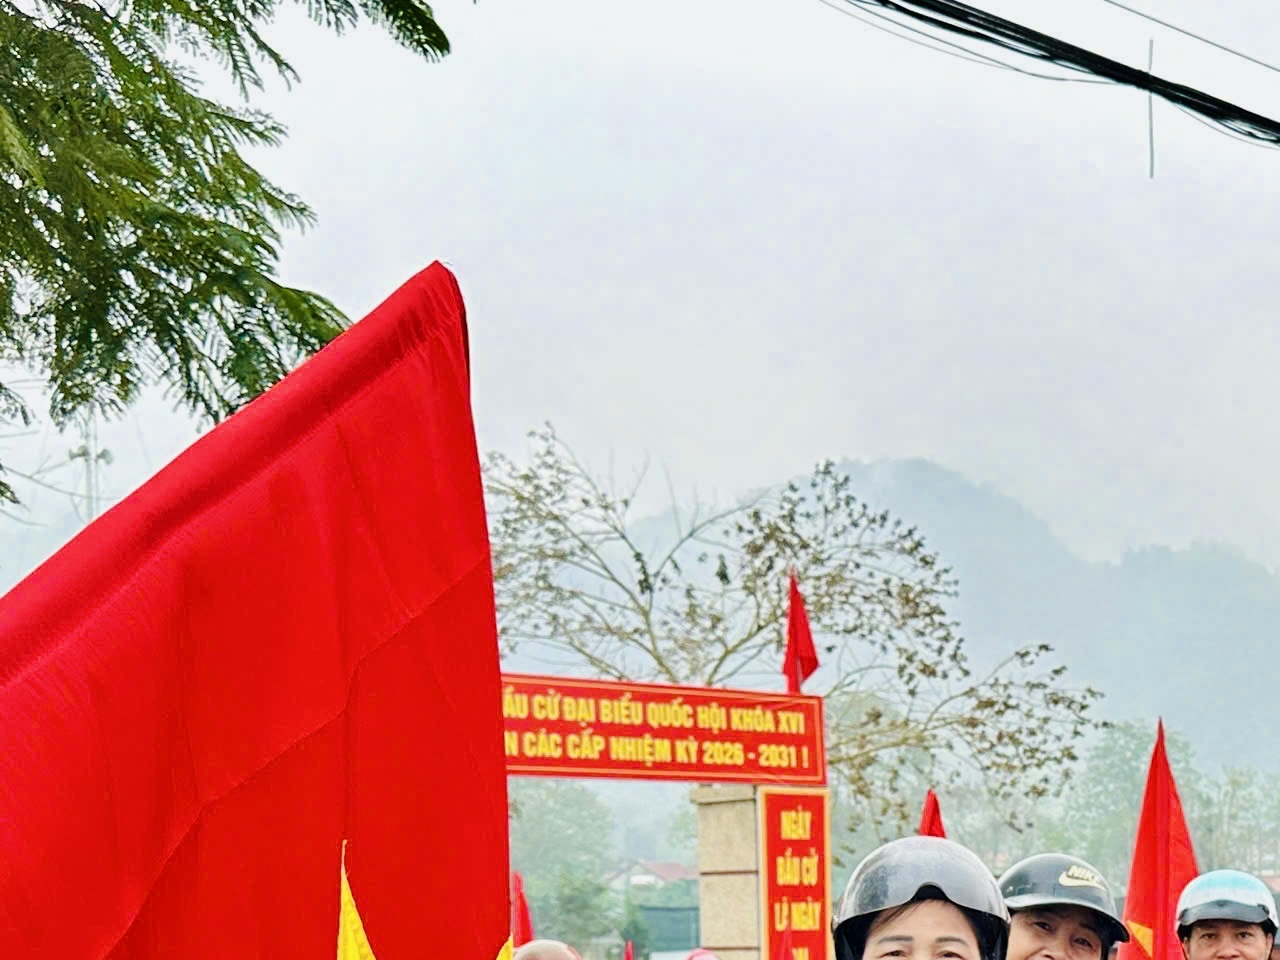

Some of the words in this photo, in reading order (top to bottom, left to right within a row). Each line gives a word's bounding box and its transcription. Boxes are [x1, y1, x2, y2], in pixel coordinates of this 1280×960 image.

[532, 689, 561, 720] CỬ
[562, 697, 596, 728] ĐẠI
[600, 692, 643, 725] BIỂU
[647, 697, 694, 729] QUỐC
[697, 702, 727, 734] HỘI
[778, 711, 806, 735] XVI
[523, 728, 563, 759] CÁC
[566, 727, 606, 760] CẤP
[609, 733, 672, 767] NHIỆM
[675, 736, 699, 764] KỲ
[702, 741, 745, 766] 2026
[758, 744, 797, 768] 2031
[780, 804, 812, 841] NGÀY
[791, 896, 821, 931] NGÀY
